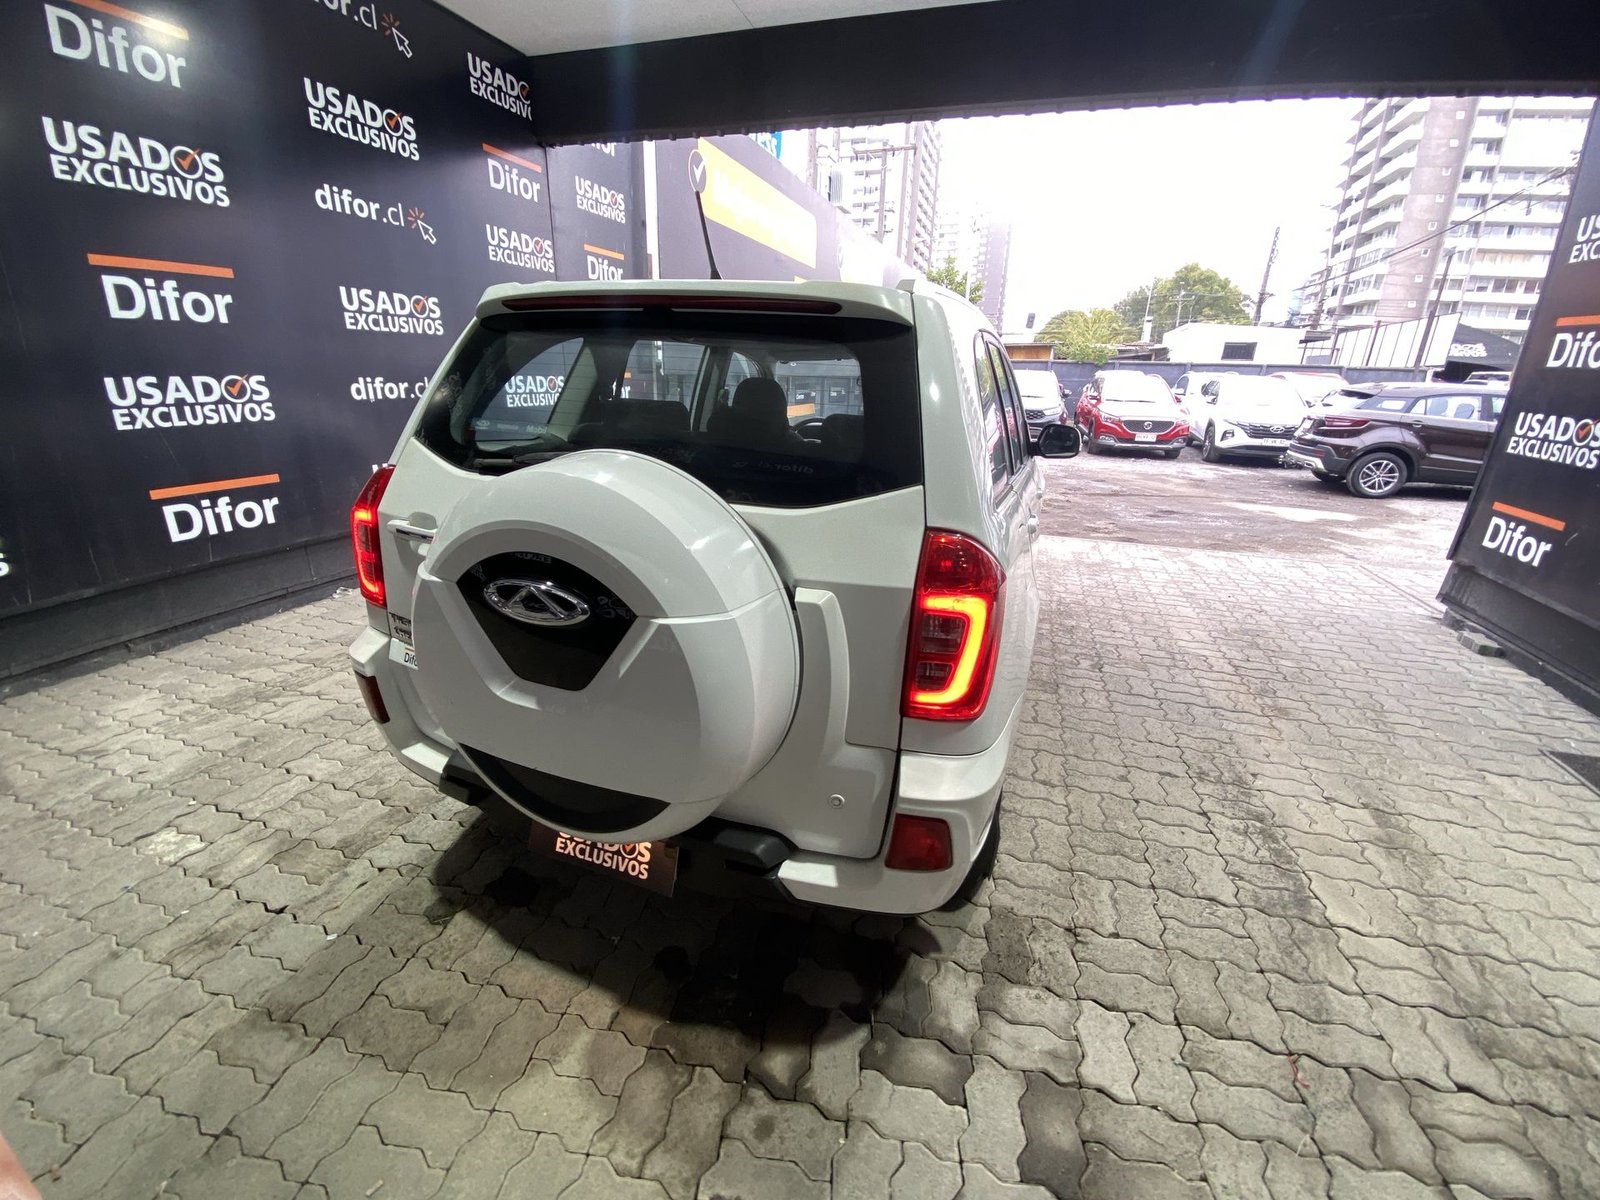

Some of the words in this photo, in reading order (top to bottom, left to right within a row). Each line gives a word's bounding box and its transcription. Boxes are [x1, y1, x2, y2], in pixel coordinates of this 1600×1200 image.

[44, 4, 187, 88] Difor
[304, 77, 417, 141] USADOS
[42, 116, 225, 183] USADOS
[308, 107, 420, 161] EXCLUSIVOS
[50, 154, 231, 208] EXCLUSIVOS
[487, 158, 541, 202] Difor
[575, 175, 625, 211] USADOS
[315, 183, 405, 227] difor.cl
[576, 197, 626, 224] EXCLUSIVOS
[486, 224, 553, 258] USADOS
[488, 246, 555, 273] EXCLUSIVOS
[587, 255, 623, 280] Difor
[101, 274, 233, 324] Difor
[339, 286, 441, 319] USADOS
[344, 312, 444, 335] EXCLUSIVOS
[104, 374, 271, 407] USADOS
[505, 375, 565, 394] USADOS
[112, 402, 276, 431] EXCLUSIVOS
[1515, 412, 1600, 447] USADOS
[1506, 436, 1600, 469] EXCLUSIVOS
[162, 496, 280, 543] Difor
[1482, 516, 1552, 568] Difor
[555, 837, 649, 879] EXCLUSIVOS
